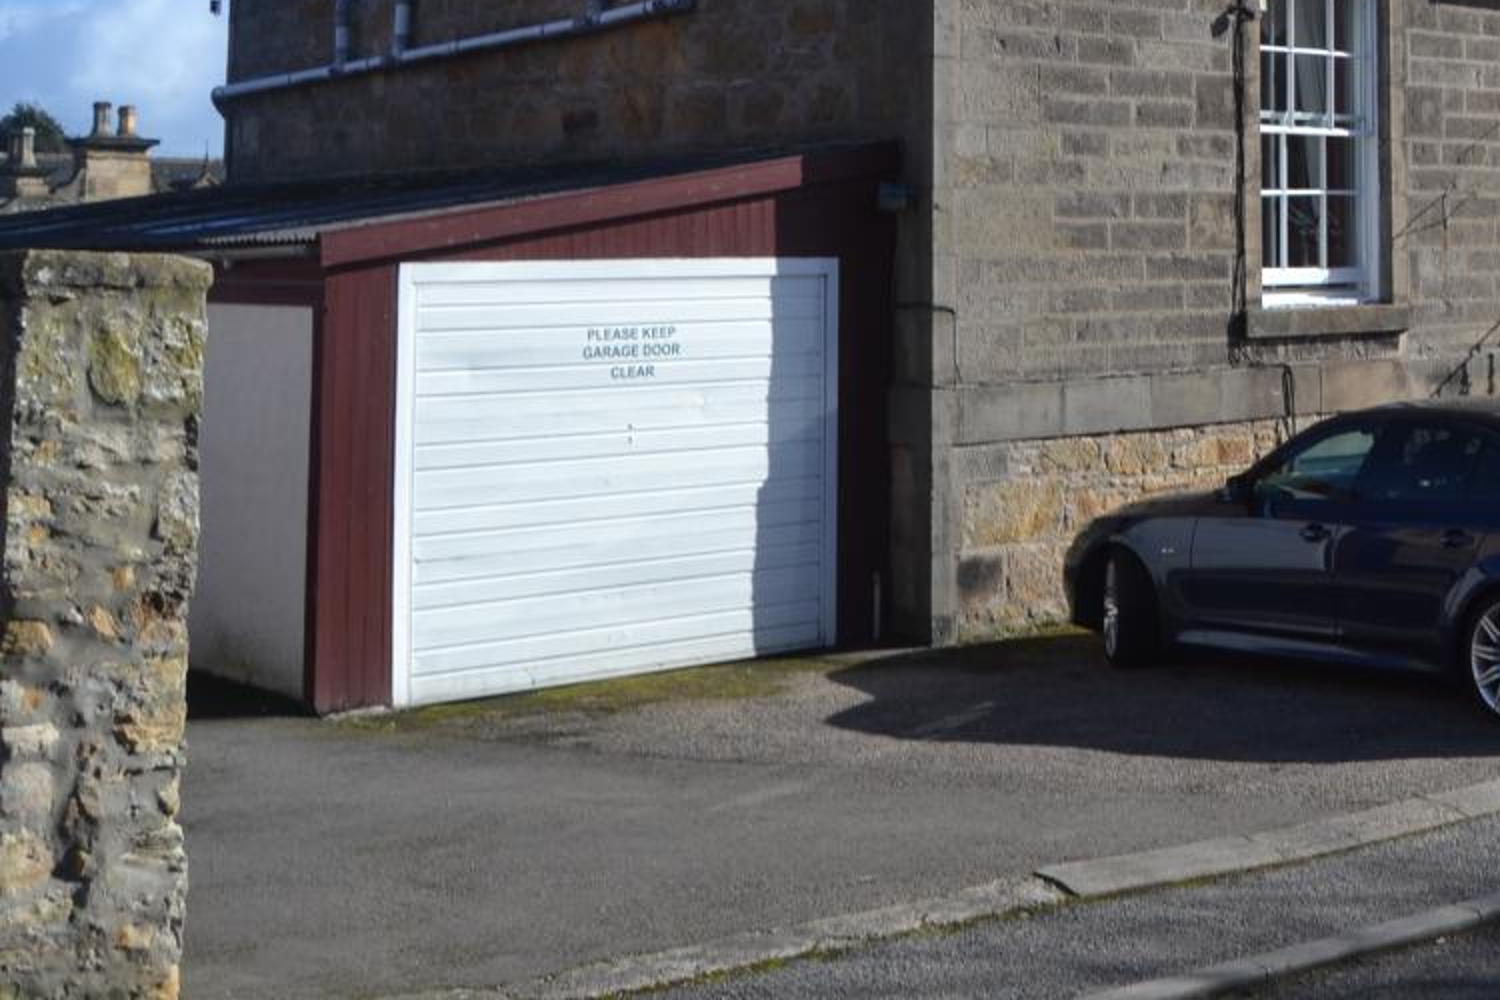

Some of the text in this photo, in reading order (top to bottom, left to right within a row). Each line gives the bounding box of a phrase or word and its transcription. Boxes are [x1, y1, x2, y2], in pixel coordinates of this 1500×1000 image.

[587, 326, 676, 341] PLEASE KEEP
[583, 343, 681, 360] GARAGE DOOR
[611, 365, 656, 379] CLEAR
